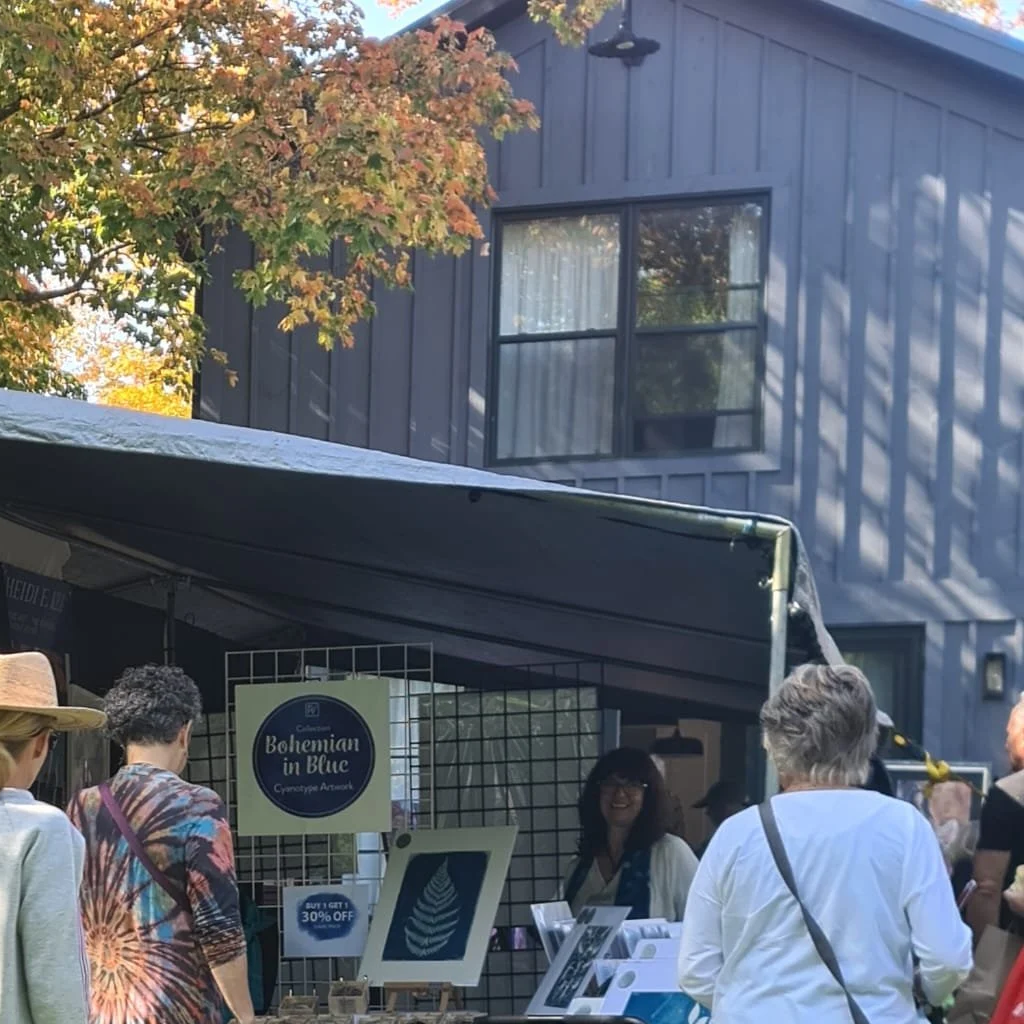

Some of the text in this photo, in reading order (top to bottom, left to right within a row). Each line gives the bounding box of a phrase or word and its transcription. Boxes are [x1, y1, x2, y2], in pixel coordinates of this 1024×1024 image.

[265, 734, 360, 755] Bohemian
[283, 754, 350, 776] in Blue
[273, 780, 353, 796] Cyanotype Artwork
[328, 901, 342, 909] GET
[302, 911, 354, 922] 30% OFF
